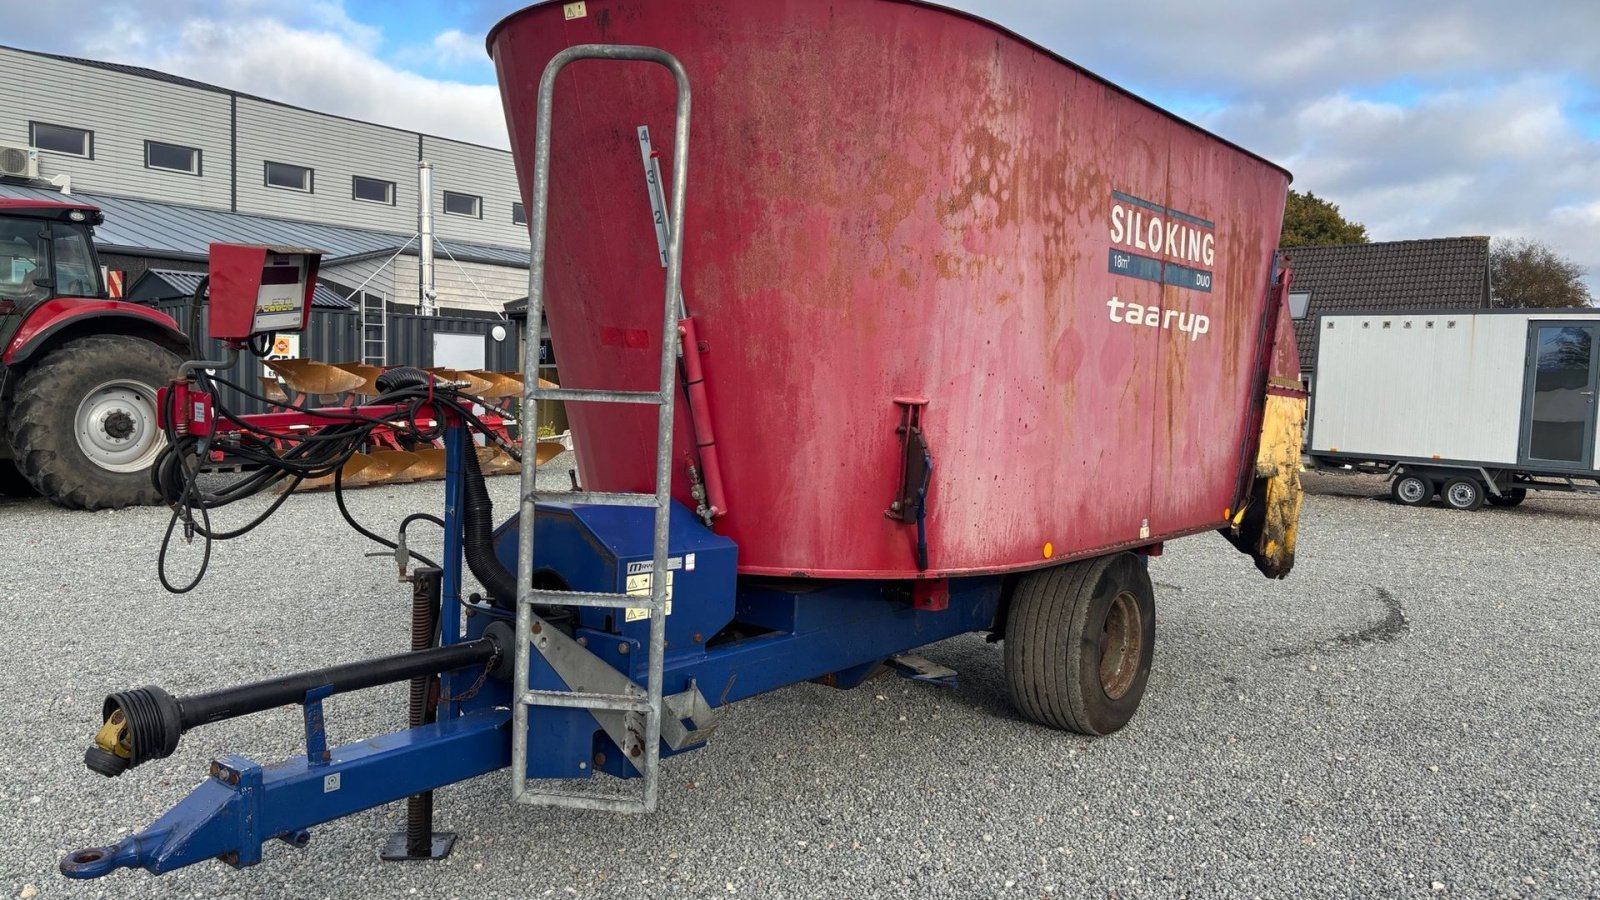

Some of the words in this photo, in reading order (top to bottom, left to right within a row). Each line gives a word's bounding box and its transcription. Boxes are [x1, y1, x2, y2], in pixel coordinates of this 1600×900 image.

[640, 129, 648, 143] 4
[647, 169, 655, 184] 3
[654, 210, 662, 224] 2
[1110, 204, 1215, 267] SILOKING
[661, 249, 668, 263] 1
[1196, 273, 1211, 288] DUO
[1106, 296, 1210, 342] taarup
